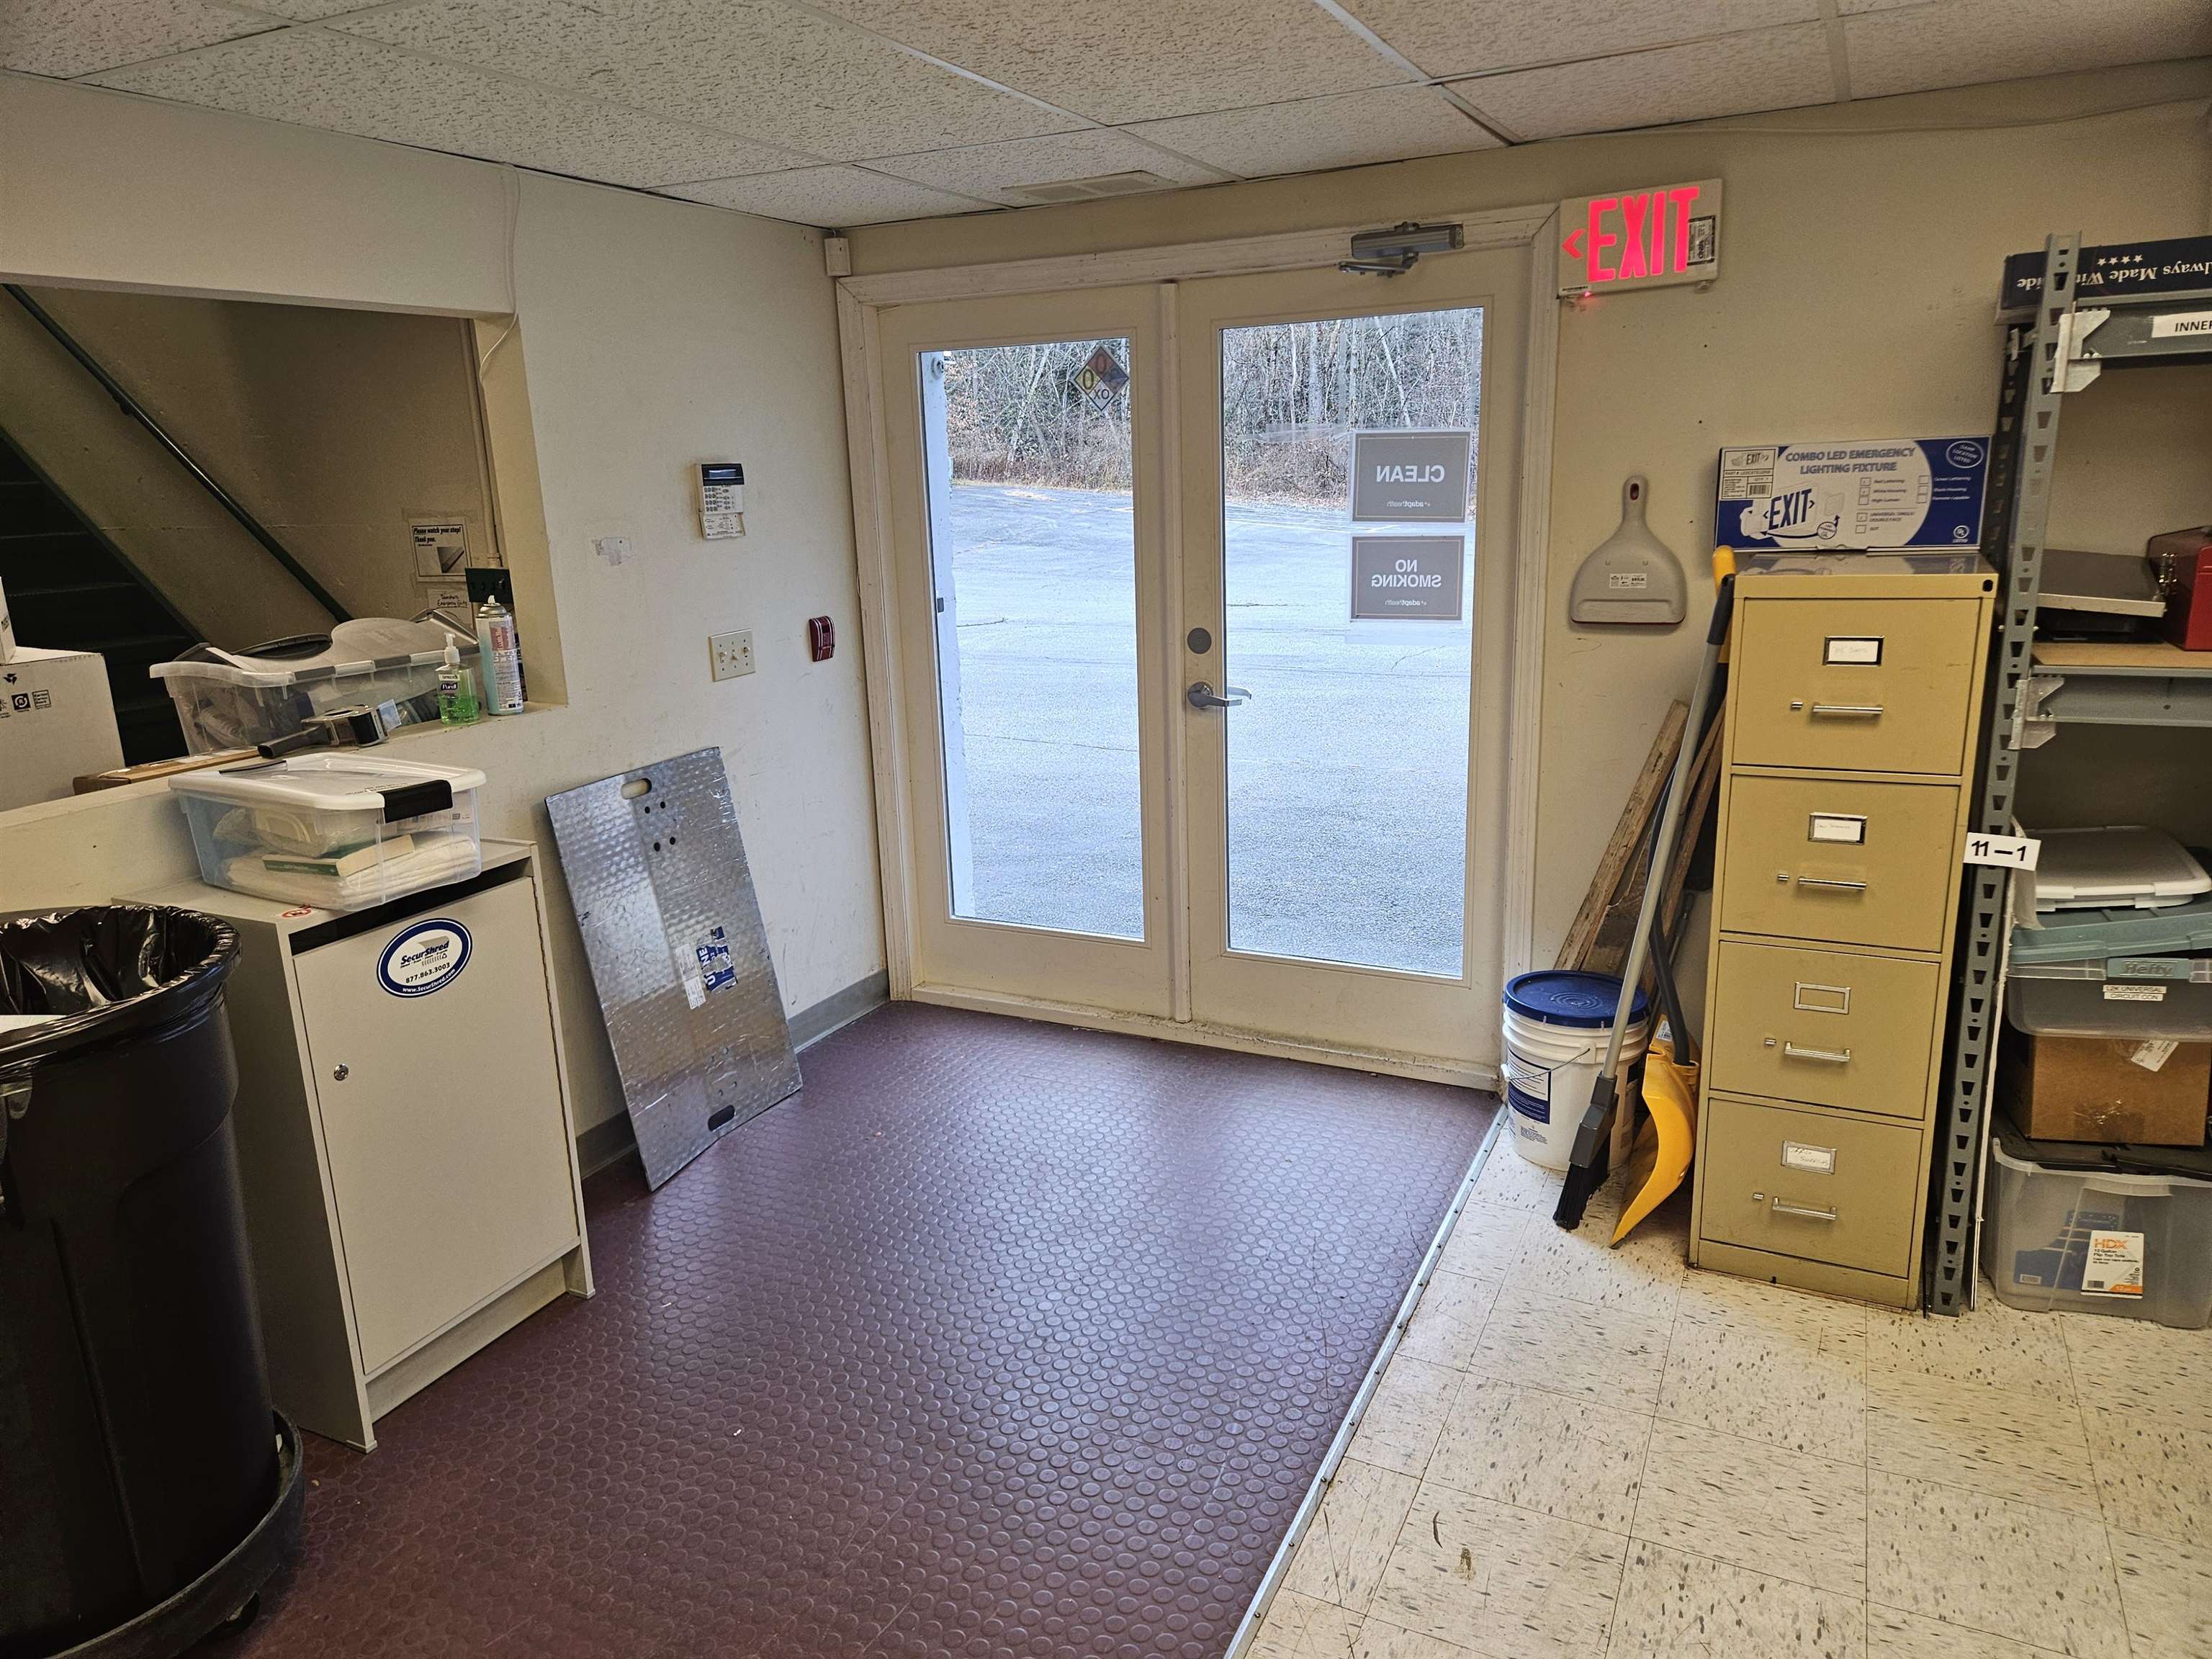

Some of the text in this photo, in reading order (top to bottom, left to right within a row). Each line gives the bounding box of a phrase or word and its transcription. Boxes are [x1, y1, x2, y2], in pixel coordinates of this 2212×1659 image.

[1587, 186, 1700, 282] EXIT
[2016, 261, 2212, 291] lways Made Wit ide
[1746, 453, 1761, 465] EXIT
[1786, 448, 1916, 462] COMBO LED EMERGENCY
[1800, 462, 1897, 475] LIGHTING FIXTURE
[1768, 488, 1812, 530] EXIT
[400, 940, 449, 965] SecurShred
[403, 968, 456, 993] www.SecurShred.com
[405, 962, 450, 984] 877.863.3003
[2094, 1238, 2128, 1249] HDX
